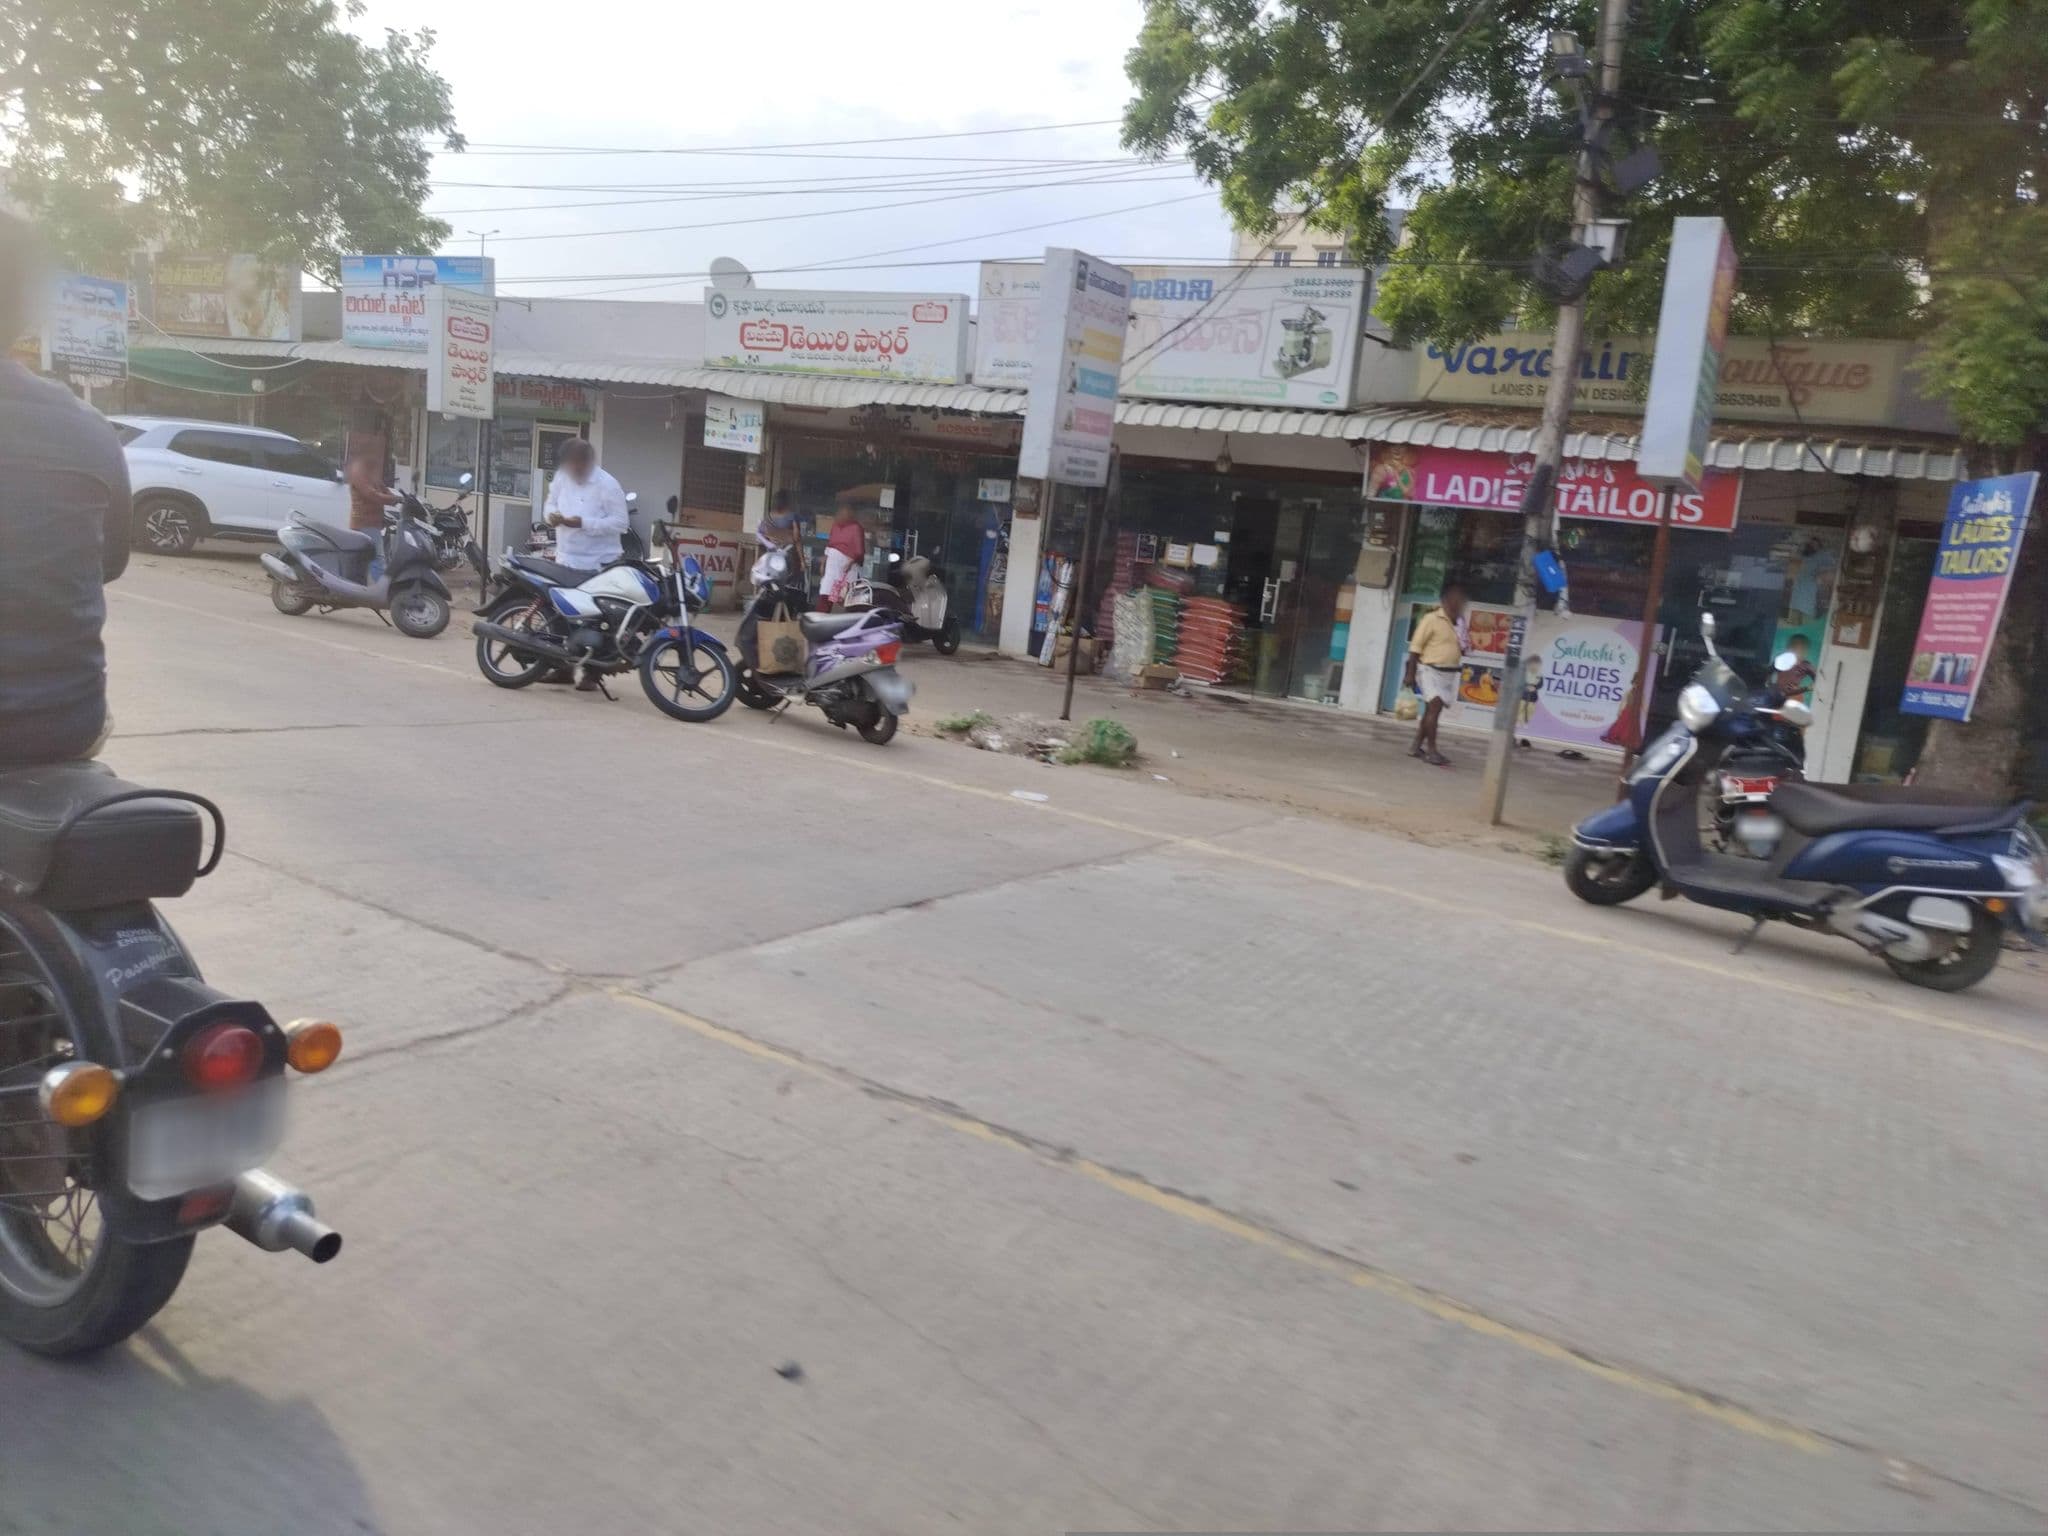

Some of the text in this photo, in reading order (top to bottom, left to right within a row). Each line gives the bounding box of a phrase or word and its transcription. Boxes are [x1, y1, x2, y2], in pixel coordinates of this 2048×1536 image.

[346, 293, 386, 313] రియల్
[789, 326, 849, 351] డెయిరి
[854, 326, 909, 363] పార్లర్
[1719, 345, 1872, 405] outique
[1491, 383, 1534, 397] LADIES
[1426, 473, 1524, 507] LADIE
[1949, 514, 2015, 545] LADIES
[1939, 546, 2011, 575] TAILORS
[1552, 637, 1627, 665] Sailushi's
[1551, 661, 1620, 684] LADIES
[1543, 676, 1624, 702] TAILORS
